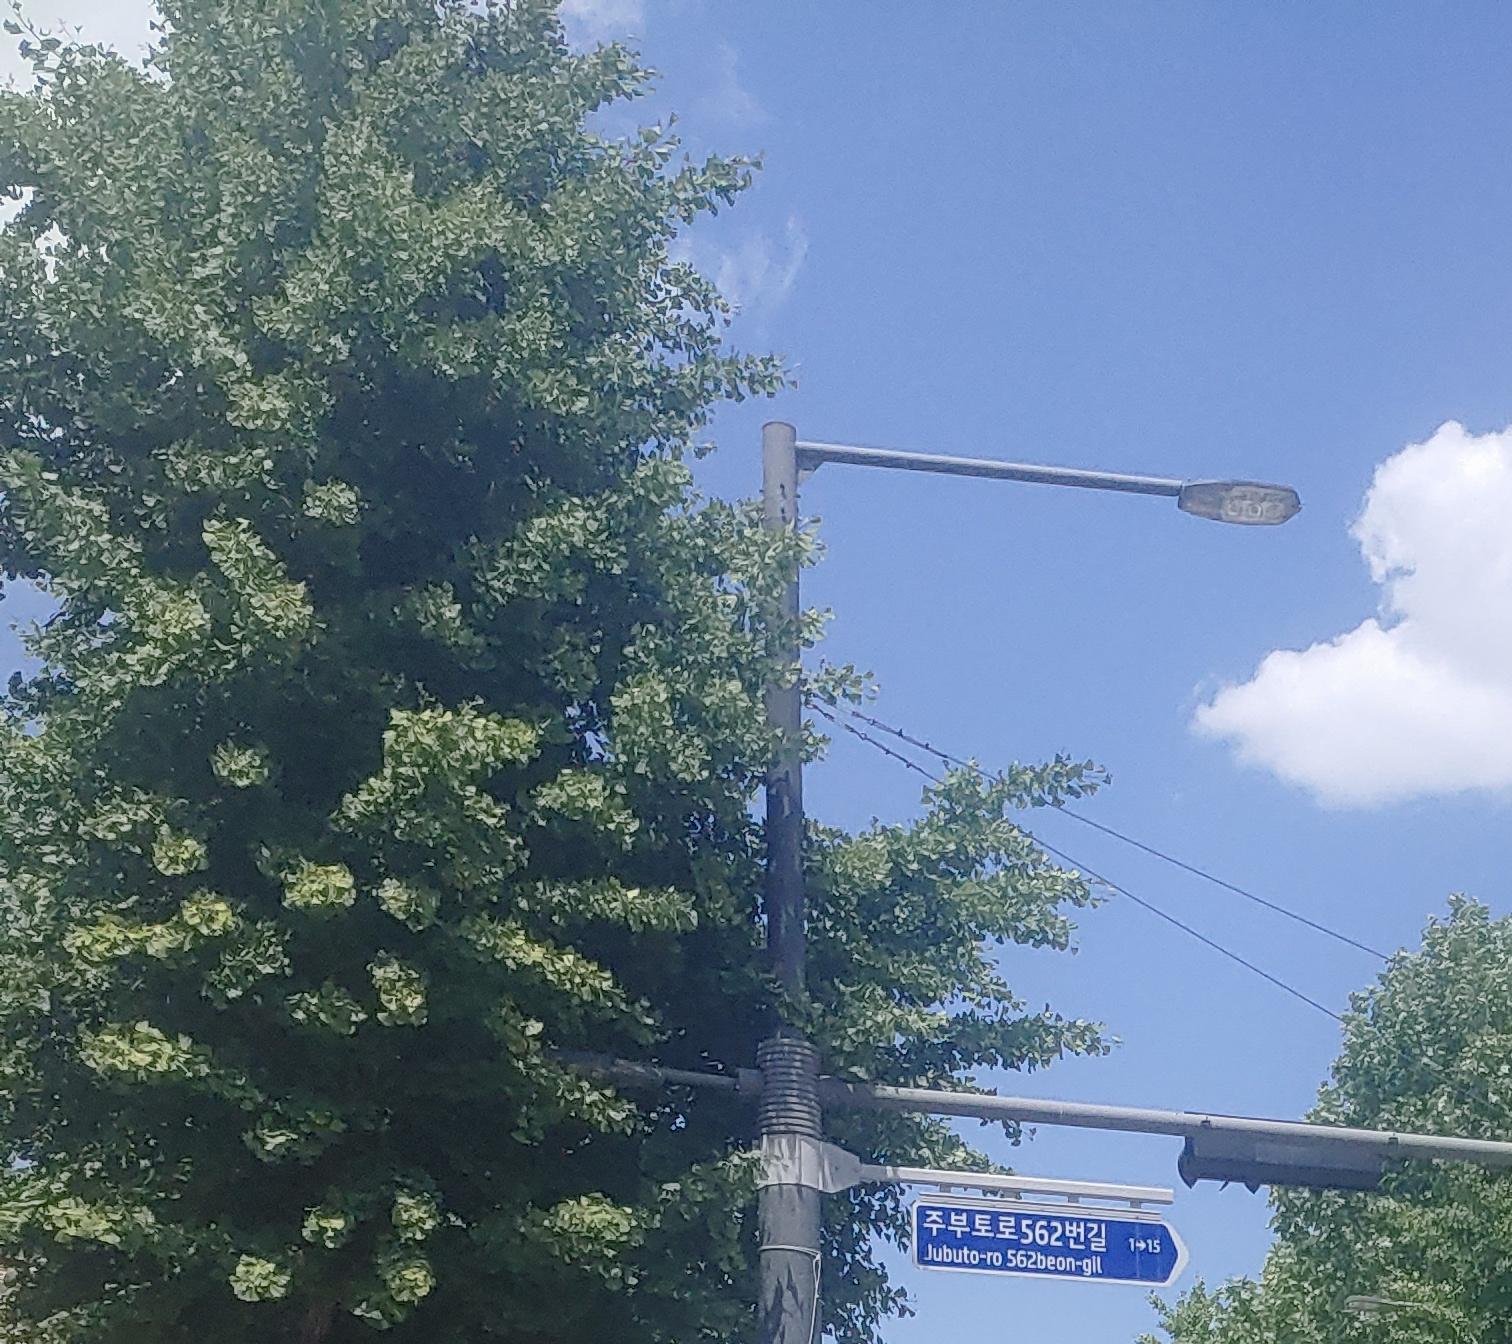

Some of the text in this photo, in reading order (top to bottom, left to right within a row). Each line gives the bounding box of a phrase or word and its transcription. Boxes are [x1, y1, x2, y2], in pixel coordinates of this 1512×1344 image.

[923, 1210, 1107, 1253] 주부토로562번길
[923, 1243, 1103, 1276] Jubuto-ro 562beon-gil
